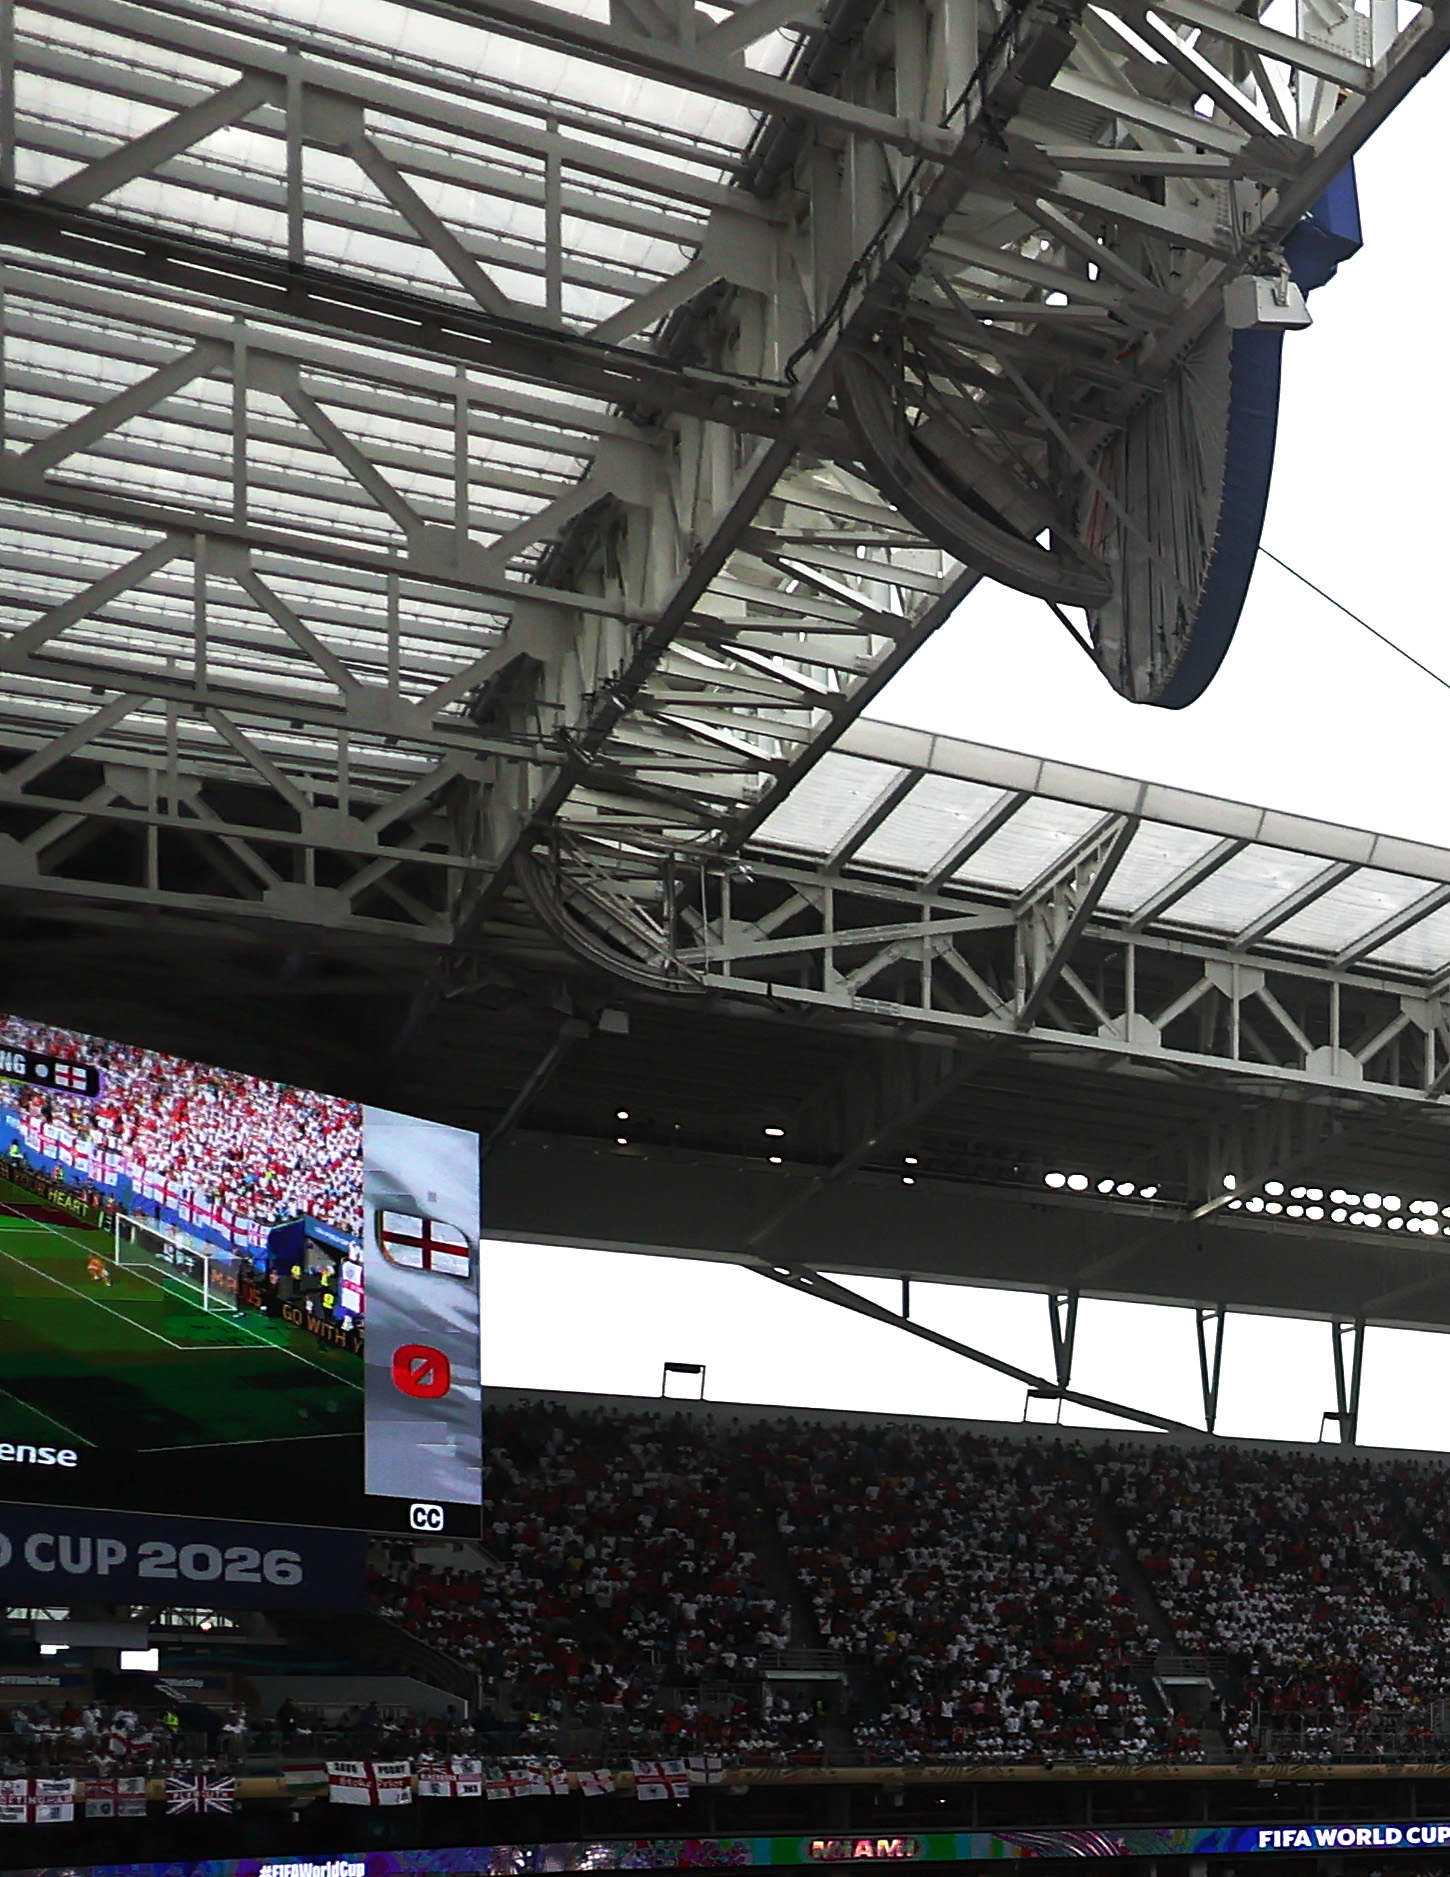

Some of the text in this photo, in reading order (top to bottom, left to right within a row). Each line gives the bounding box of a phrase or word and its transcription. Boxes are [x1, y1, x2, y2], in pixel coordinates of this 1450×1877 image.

[48, 1189, 89, 1217] HEART
[282, 1304, 346, 1347] GO WITH
[412, 1507, 441, 1528] CC
[25, 1533, 126, 1575] CUP
[138, 1542, 302, 1585] 2026
[812, 1838, 916, 1858] MIAMI
[1259, 1830, 1311, 1847] FIFA
[1315, 1828, 1402, 1846] WORLD
